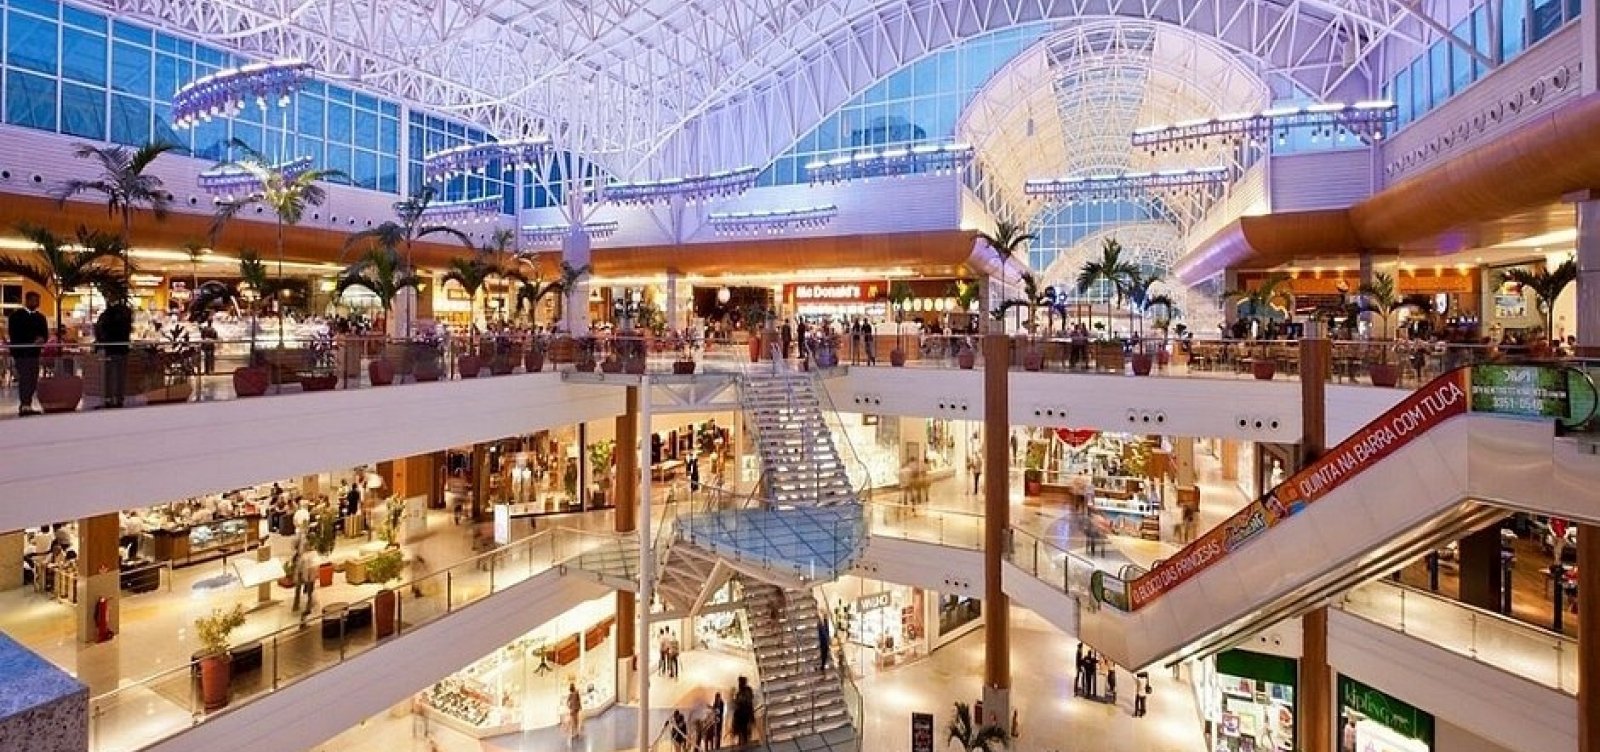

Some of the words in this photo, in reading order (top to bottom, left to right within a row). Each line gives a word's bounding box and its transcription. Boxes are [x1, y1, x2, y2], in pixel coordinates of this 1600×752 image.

[1300, 463, 1341, 498] QUINTA
[1338, 452, 1358, 475] NA
[1353, 425, 1398, 462] BARRA
[1392, 406, 1427, 436] COM
[1420, 381, 1465, 417] TUCA
[1176, 538, 1220, 578] PRINCESAS
